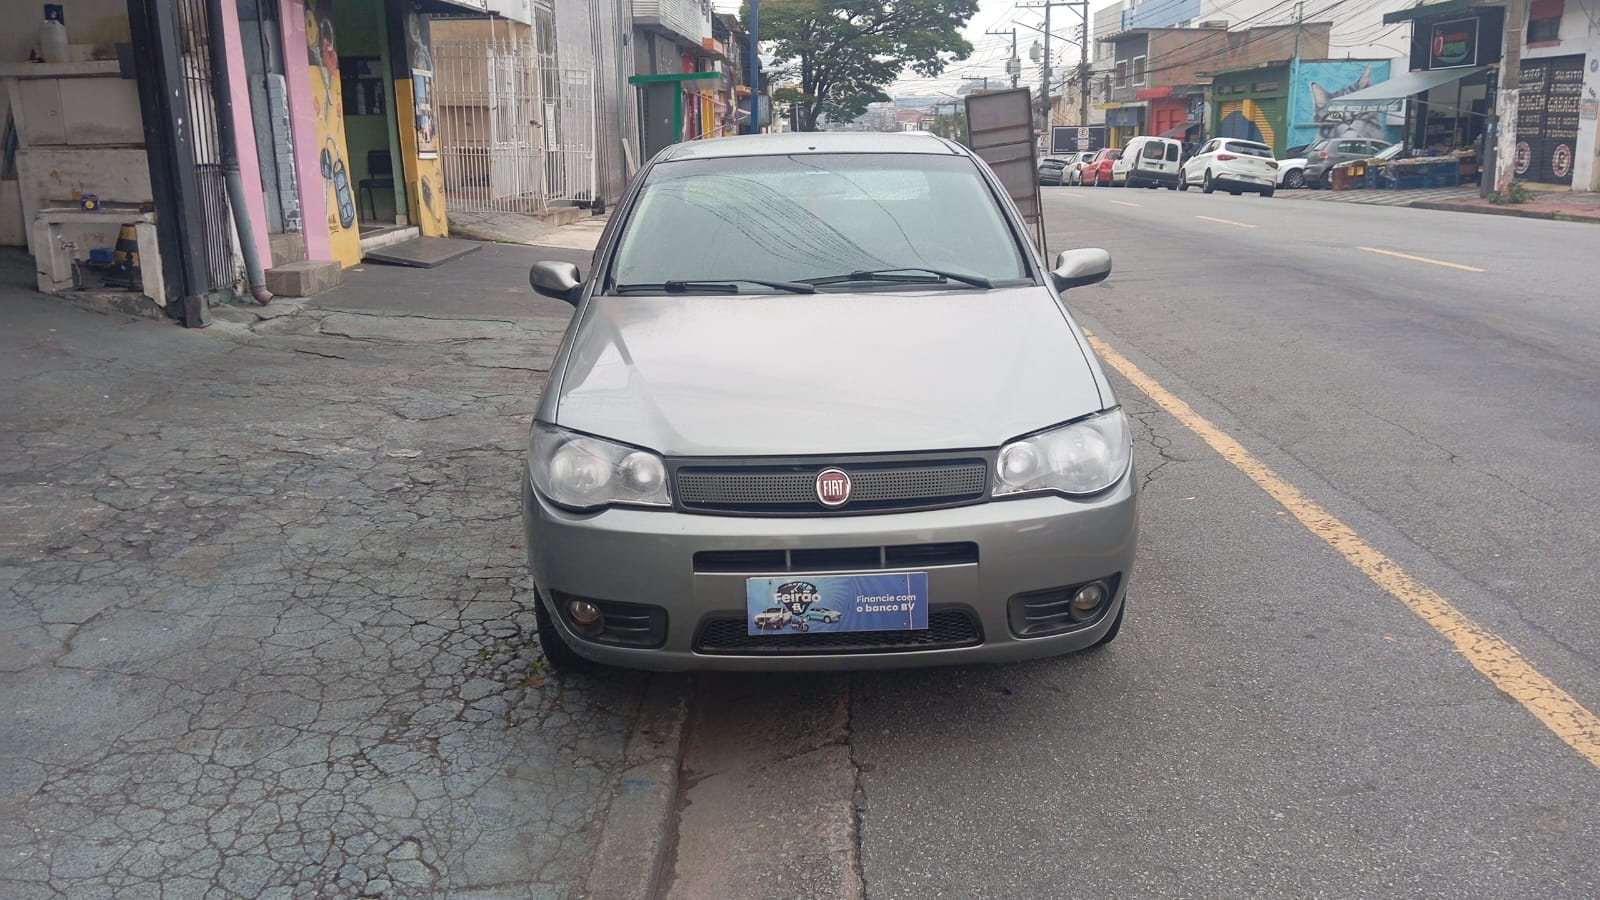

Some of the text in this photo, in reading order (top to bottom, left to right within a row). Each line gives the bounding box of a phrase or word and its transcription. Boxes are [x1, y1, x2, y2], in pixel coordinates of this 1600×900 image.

[823, 479, 844, 497] FIAT
[773, 590, 822, 604] Feirão
[856, 594, 895, 603] Financie
[856, 603, 915, 613] o banco BV
